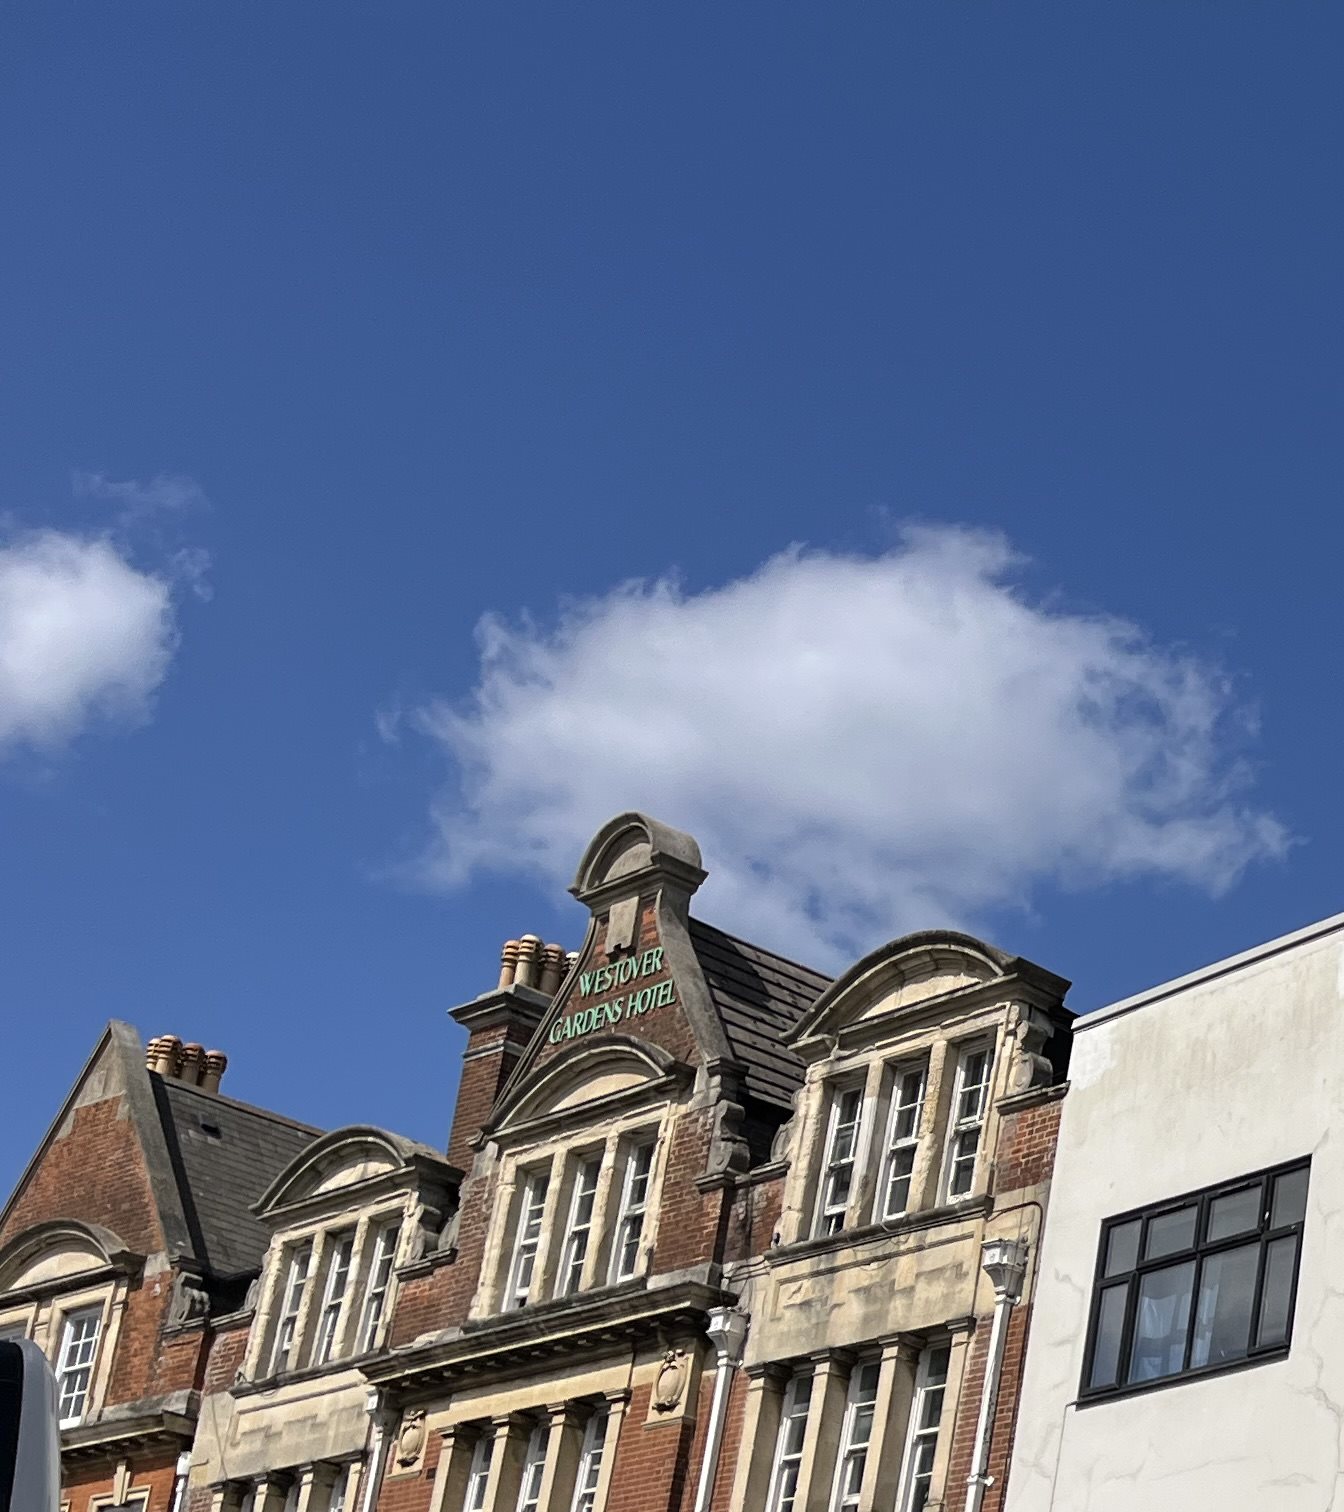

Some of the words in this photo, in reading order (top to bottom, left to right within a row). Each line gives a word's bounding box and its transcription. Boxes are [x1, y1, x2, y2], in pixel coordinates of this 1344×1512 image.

[580, 946, 665, 998] WESTOVER
[549, 996, 625, 1045] GARDENS
[626, 978, 677, 1019] HOTEL
